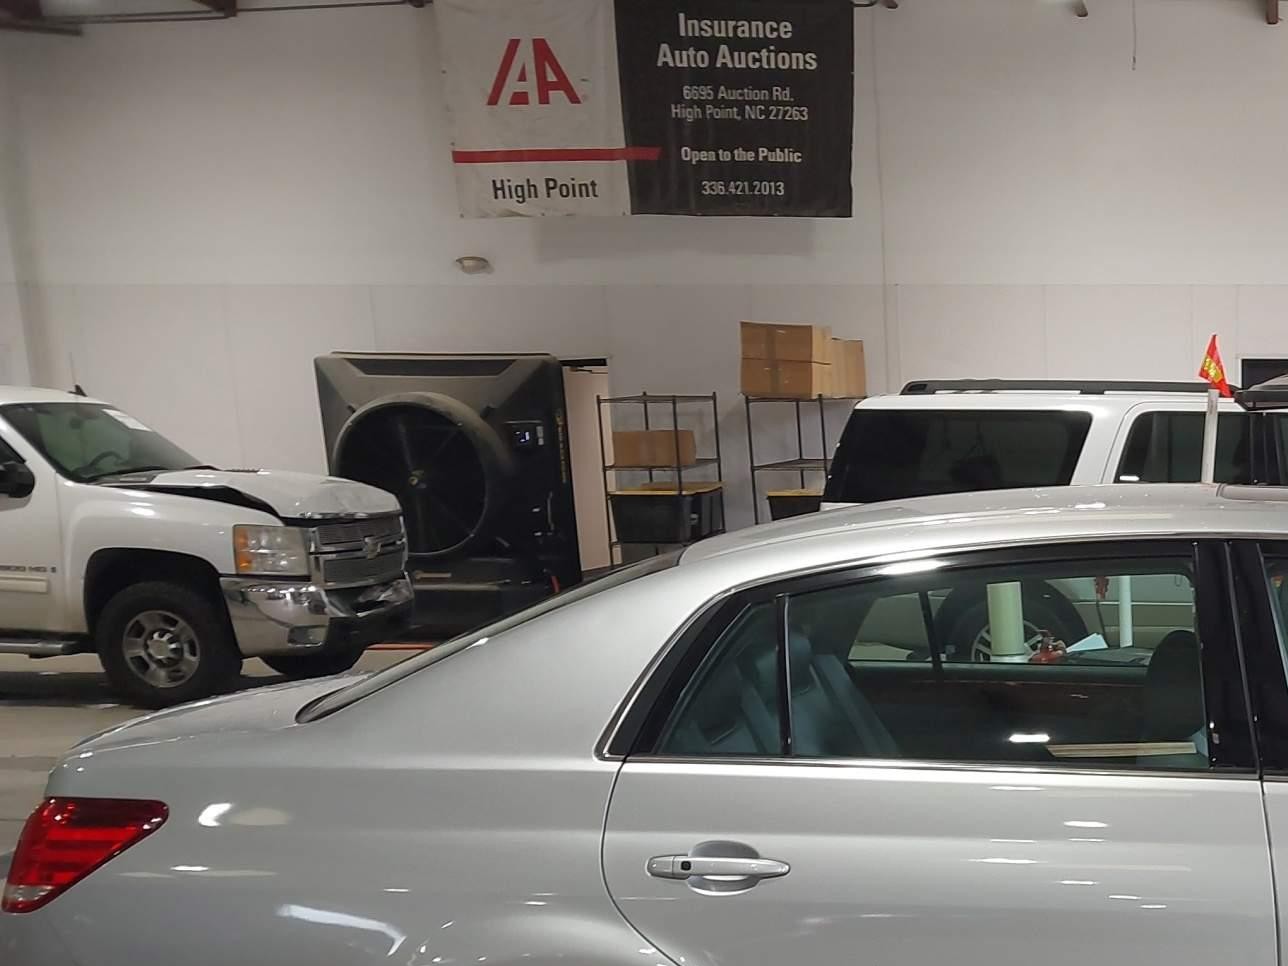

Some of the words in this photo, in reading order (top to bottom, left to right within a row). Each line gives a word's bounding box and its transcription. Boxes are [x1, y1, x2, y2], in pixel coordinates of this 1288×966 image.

[678, 12, 793, 40] Insurance
[656, 43, 709, 69] Auto
[715, 44, 818, 71] Auctions
[682, 85, 714, 101] 6695
[717, 85, 769, 102] Auction
[772, 86, 794, 102] Rd.
[671, 104, 702, 122] High
[705, 105, 741, 121] Point,
[744, 105, 766, 120] NC
[769, 105, 809, 121] 27263
[680, 146, 715, 164] Open
[718, 147, 731, 162] to
[734, 147, 755, 162] the
[758, 147, 803, 163] Public
[491, 178, 539, 204] High
[544, 177, 599, 200] Point
[701, 180, 785, 197] 336.421.2013
